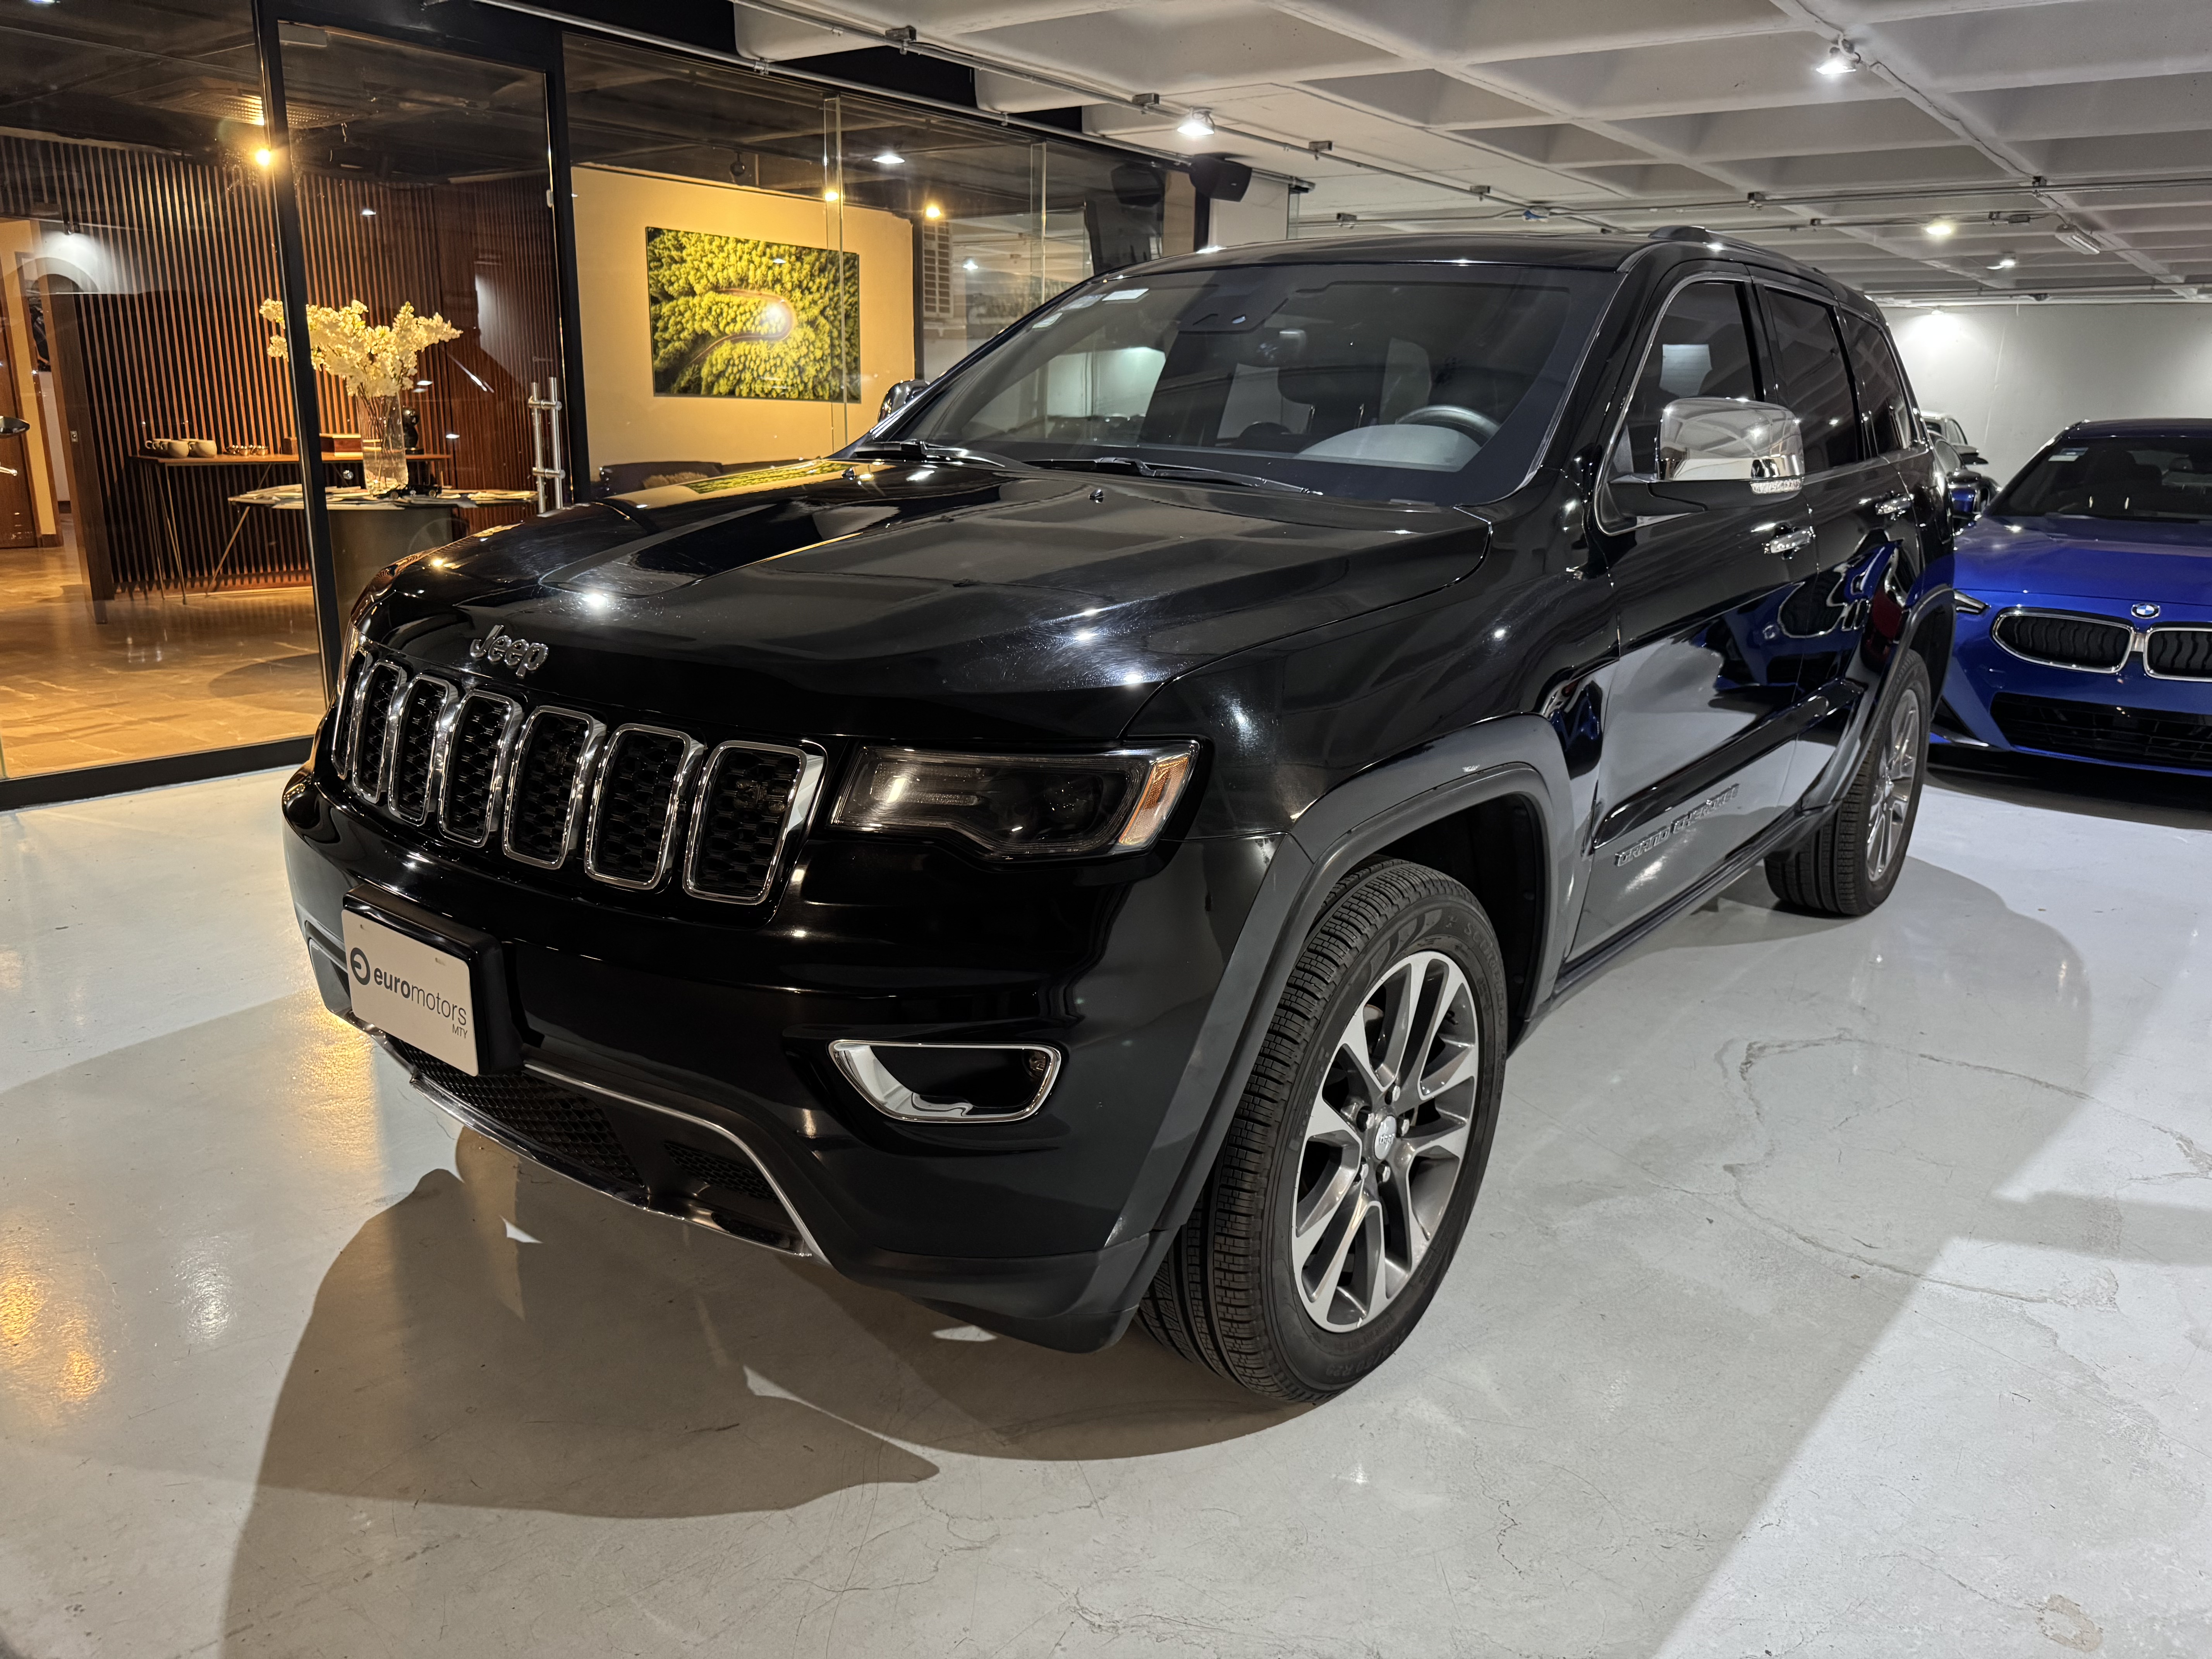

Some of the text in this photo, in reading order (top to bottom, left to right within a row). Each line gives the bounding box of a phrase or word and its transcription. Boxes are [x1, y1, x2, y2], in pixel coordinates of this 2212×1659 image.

[470, 625, 549, 677] Jeep
[374, 967, 467, 1026] euromotors
[452, 1024, 468, 1039] MTY
